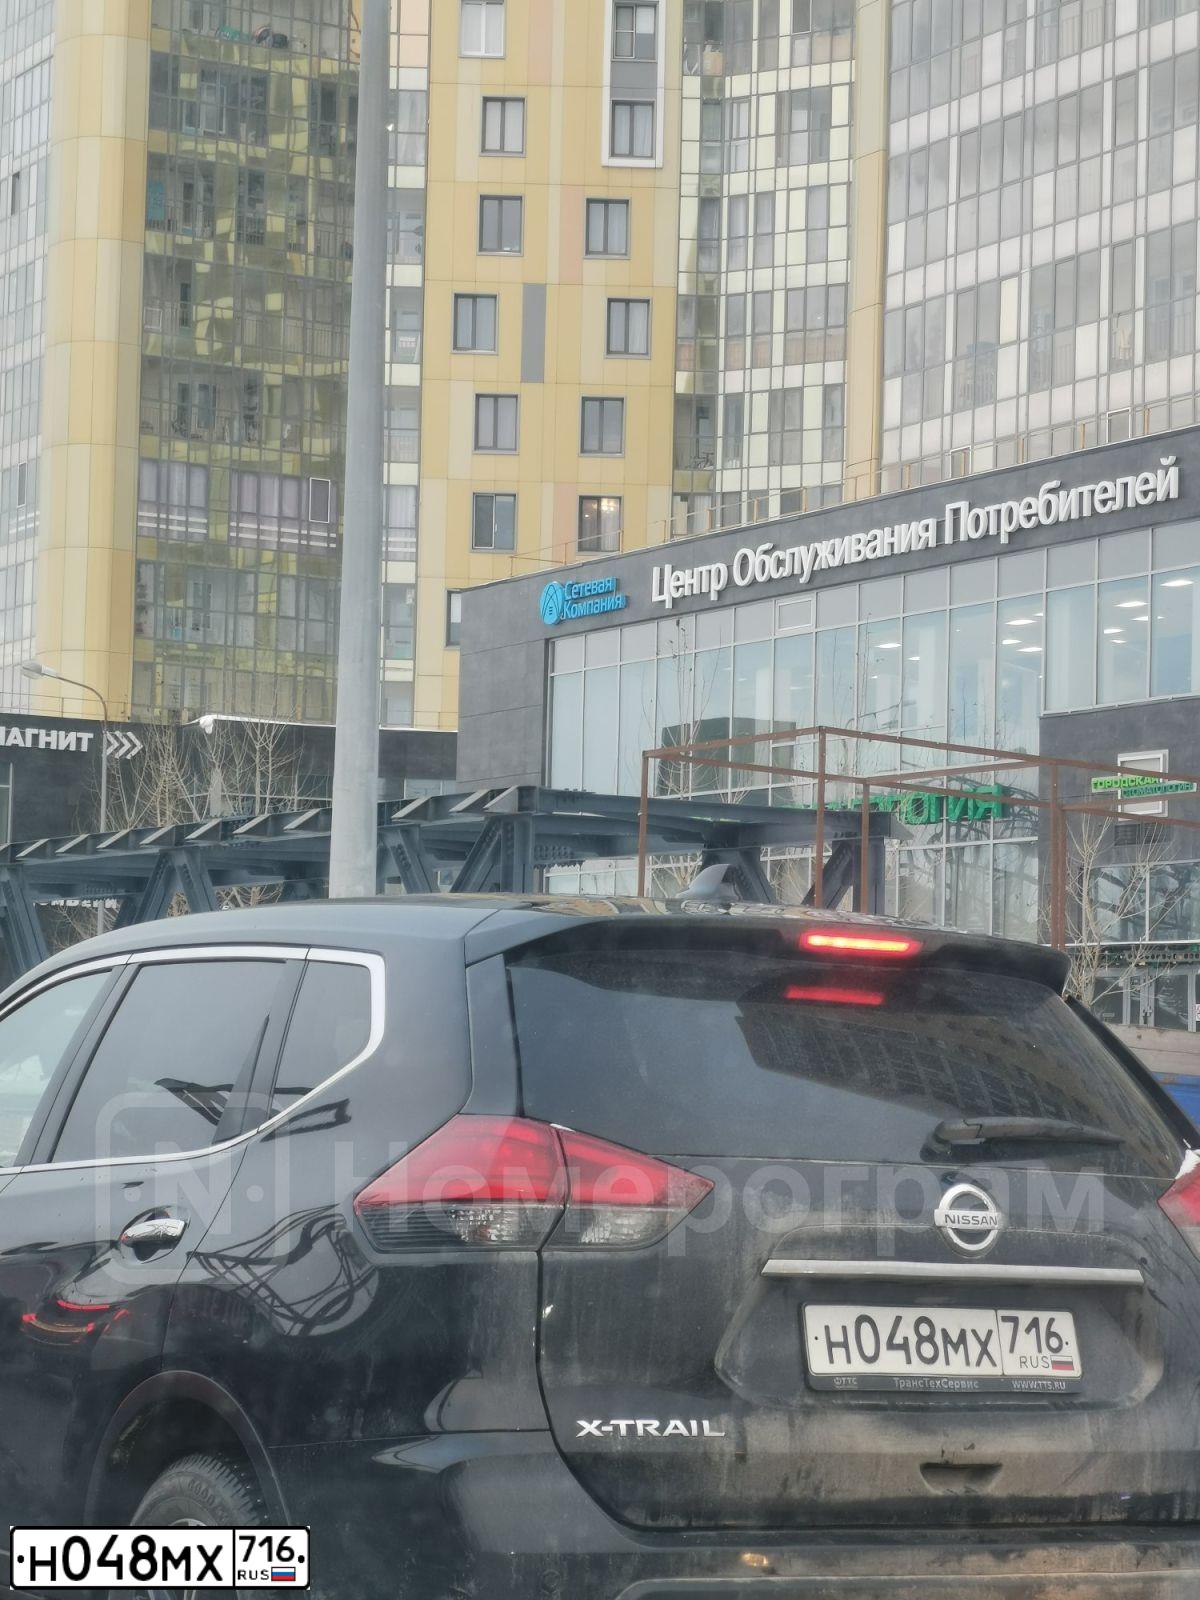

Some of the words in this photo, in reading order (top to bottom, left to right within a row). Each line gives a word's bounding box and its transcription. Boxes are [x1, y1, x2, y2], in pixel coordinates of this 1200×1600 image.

[652, 563, 729, 609] Центр
[733, 518, 937, 587] Обслуживания
[944, 456, 1179, 544] Потребителей
[564, 576, 616, 600] Сетевая
[562, 593, 624, 619] Компания
[944, 1214, 998, 1226] NISSAN
[824, 1313, 998, 1368] Н048МХ
[1001, 1315, 1064, 1354] 716
[1019, 1355, 1050, 1369] RUS
[893, 1377, 979, 1389] ТрансТехСервис
[575, 1419, 726, 1438] X-TRAIL
